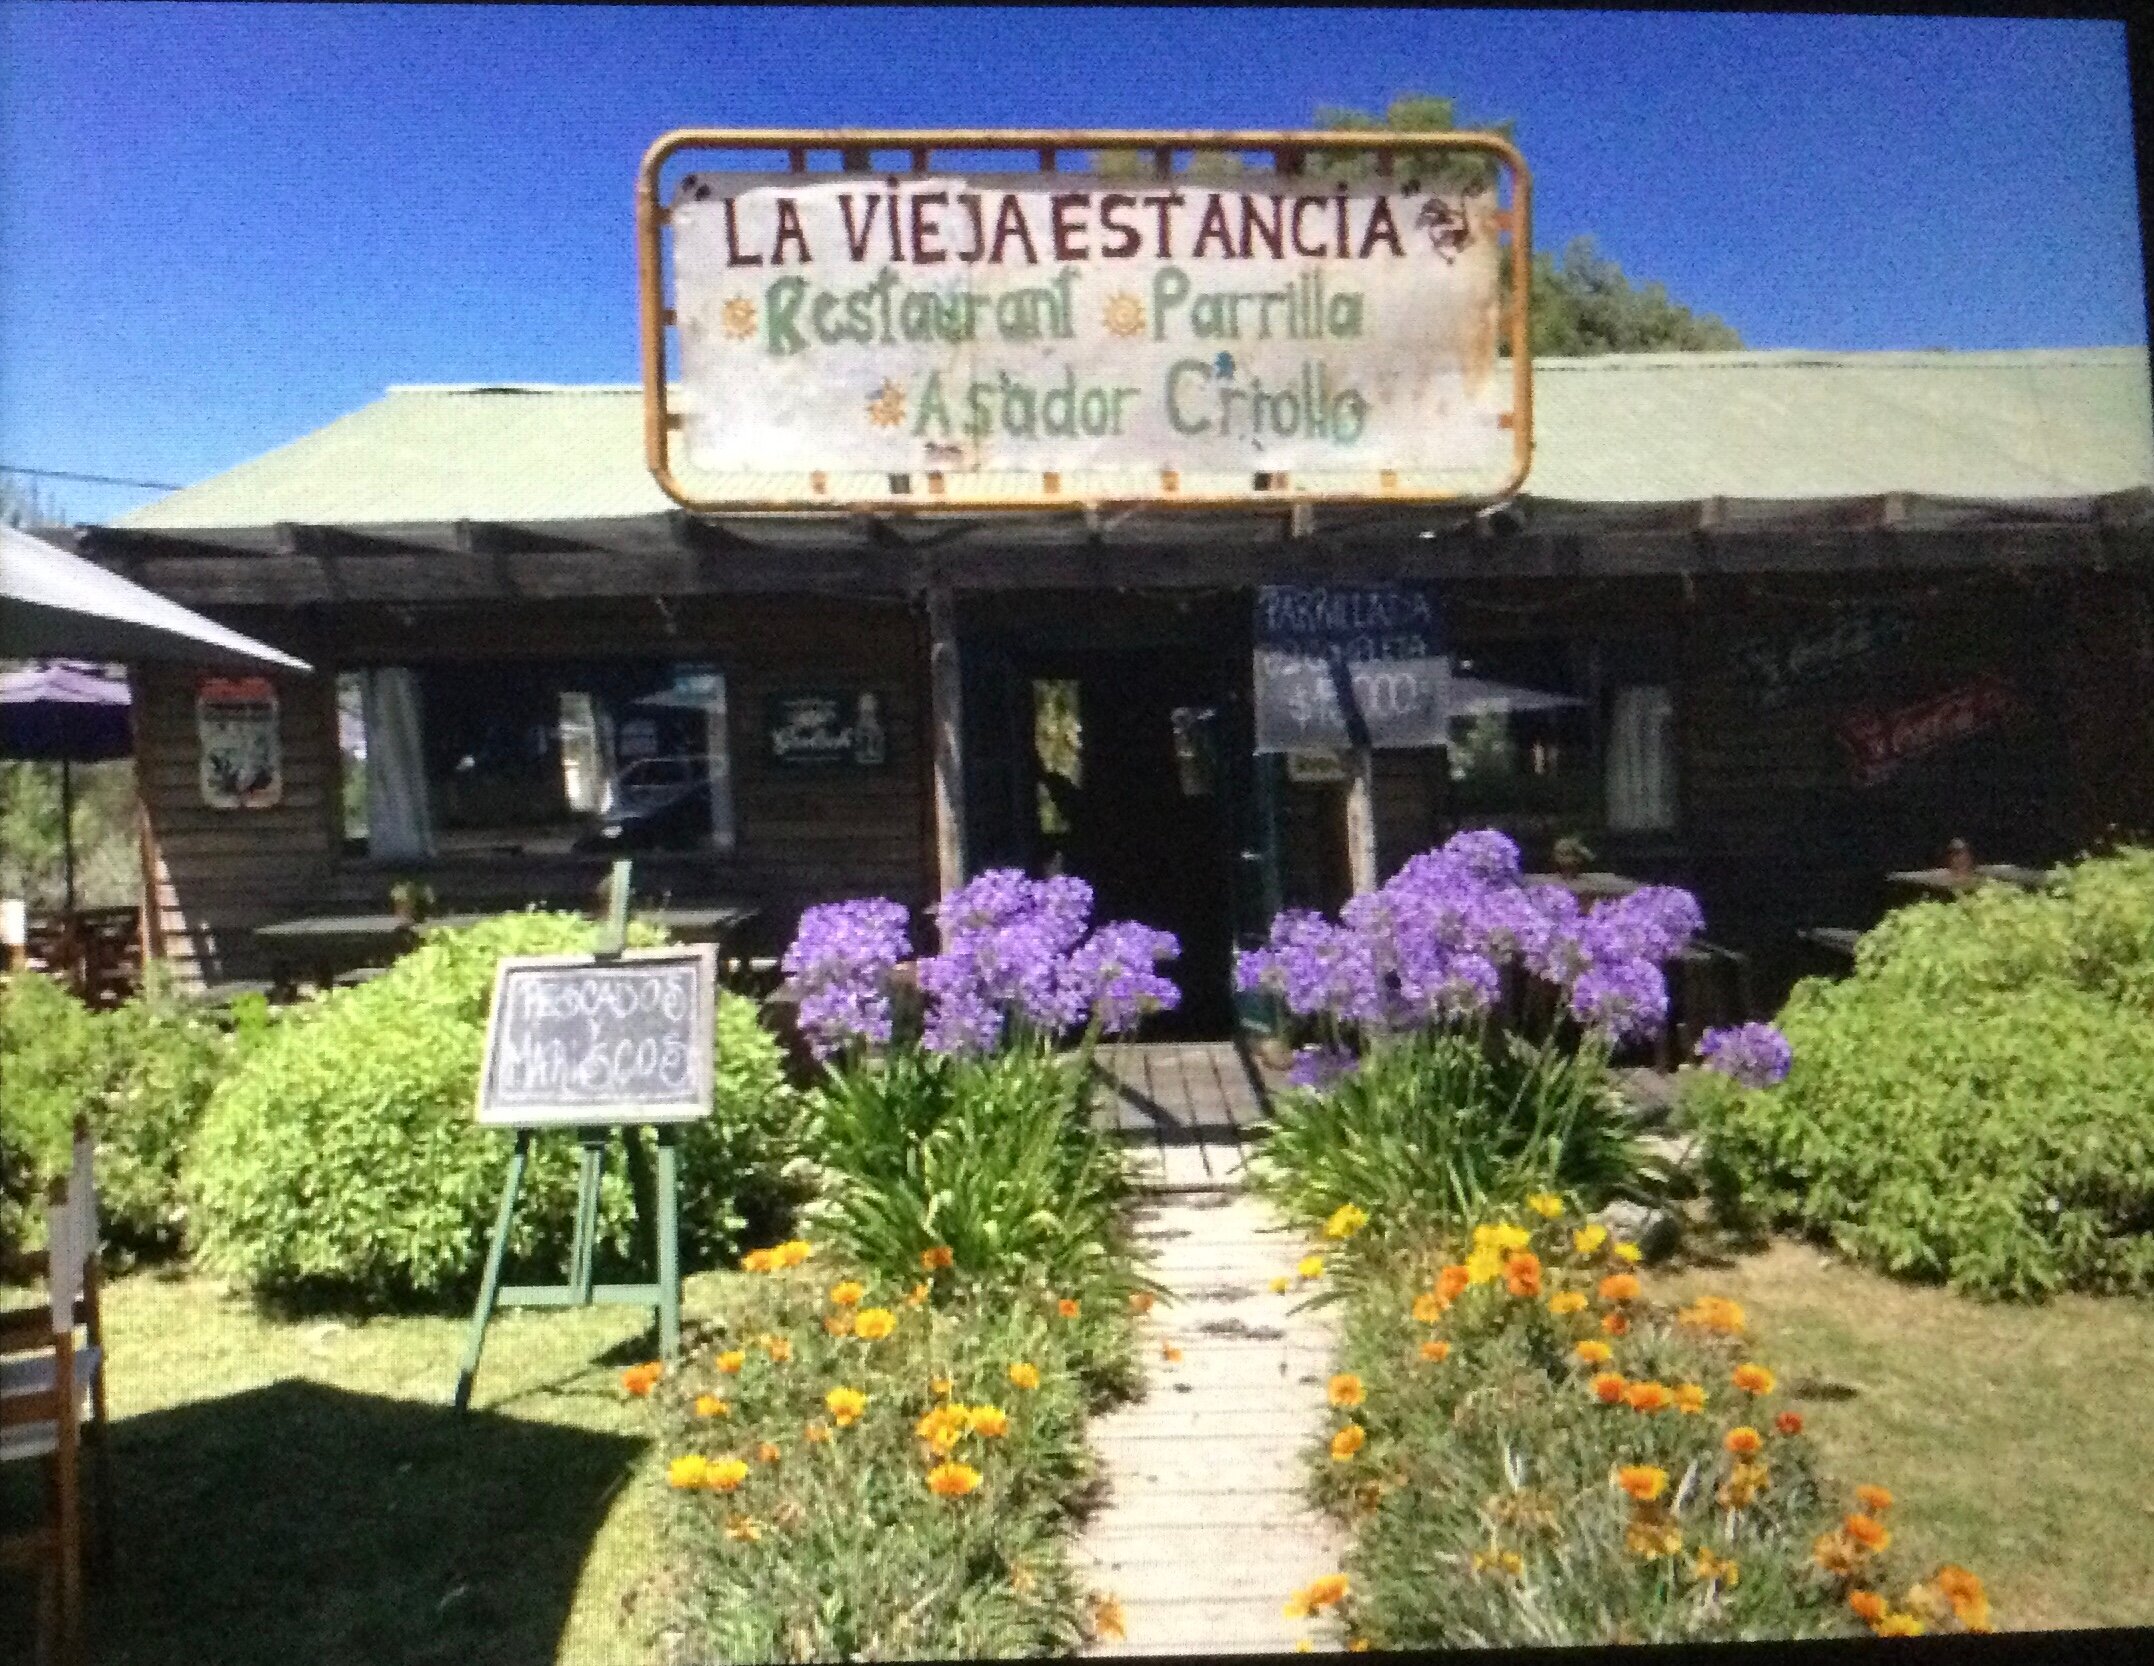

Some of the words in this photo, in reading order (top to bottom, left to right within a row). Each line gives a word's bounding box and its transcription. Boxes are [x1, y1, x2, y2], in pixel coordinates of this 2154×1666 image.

[724, 197, 813, 267] LA
[765, 265, 1082, 356] Restaurant
[1152, 265, 1365, 341] Parrilla
[911, 362, 1141, 439] Asador
[1164, 356, 1370, 444] Criollo
